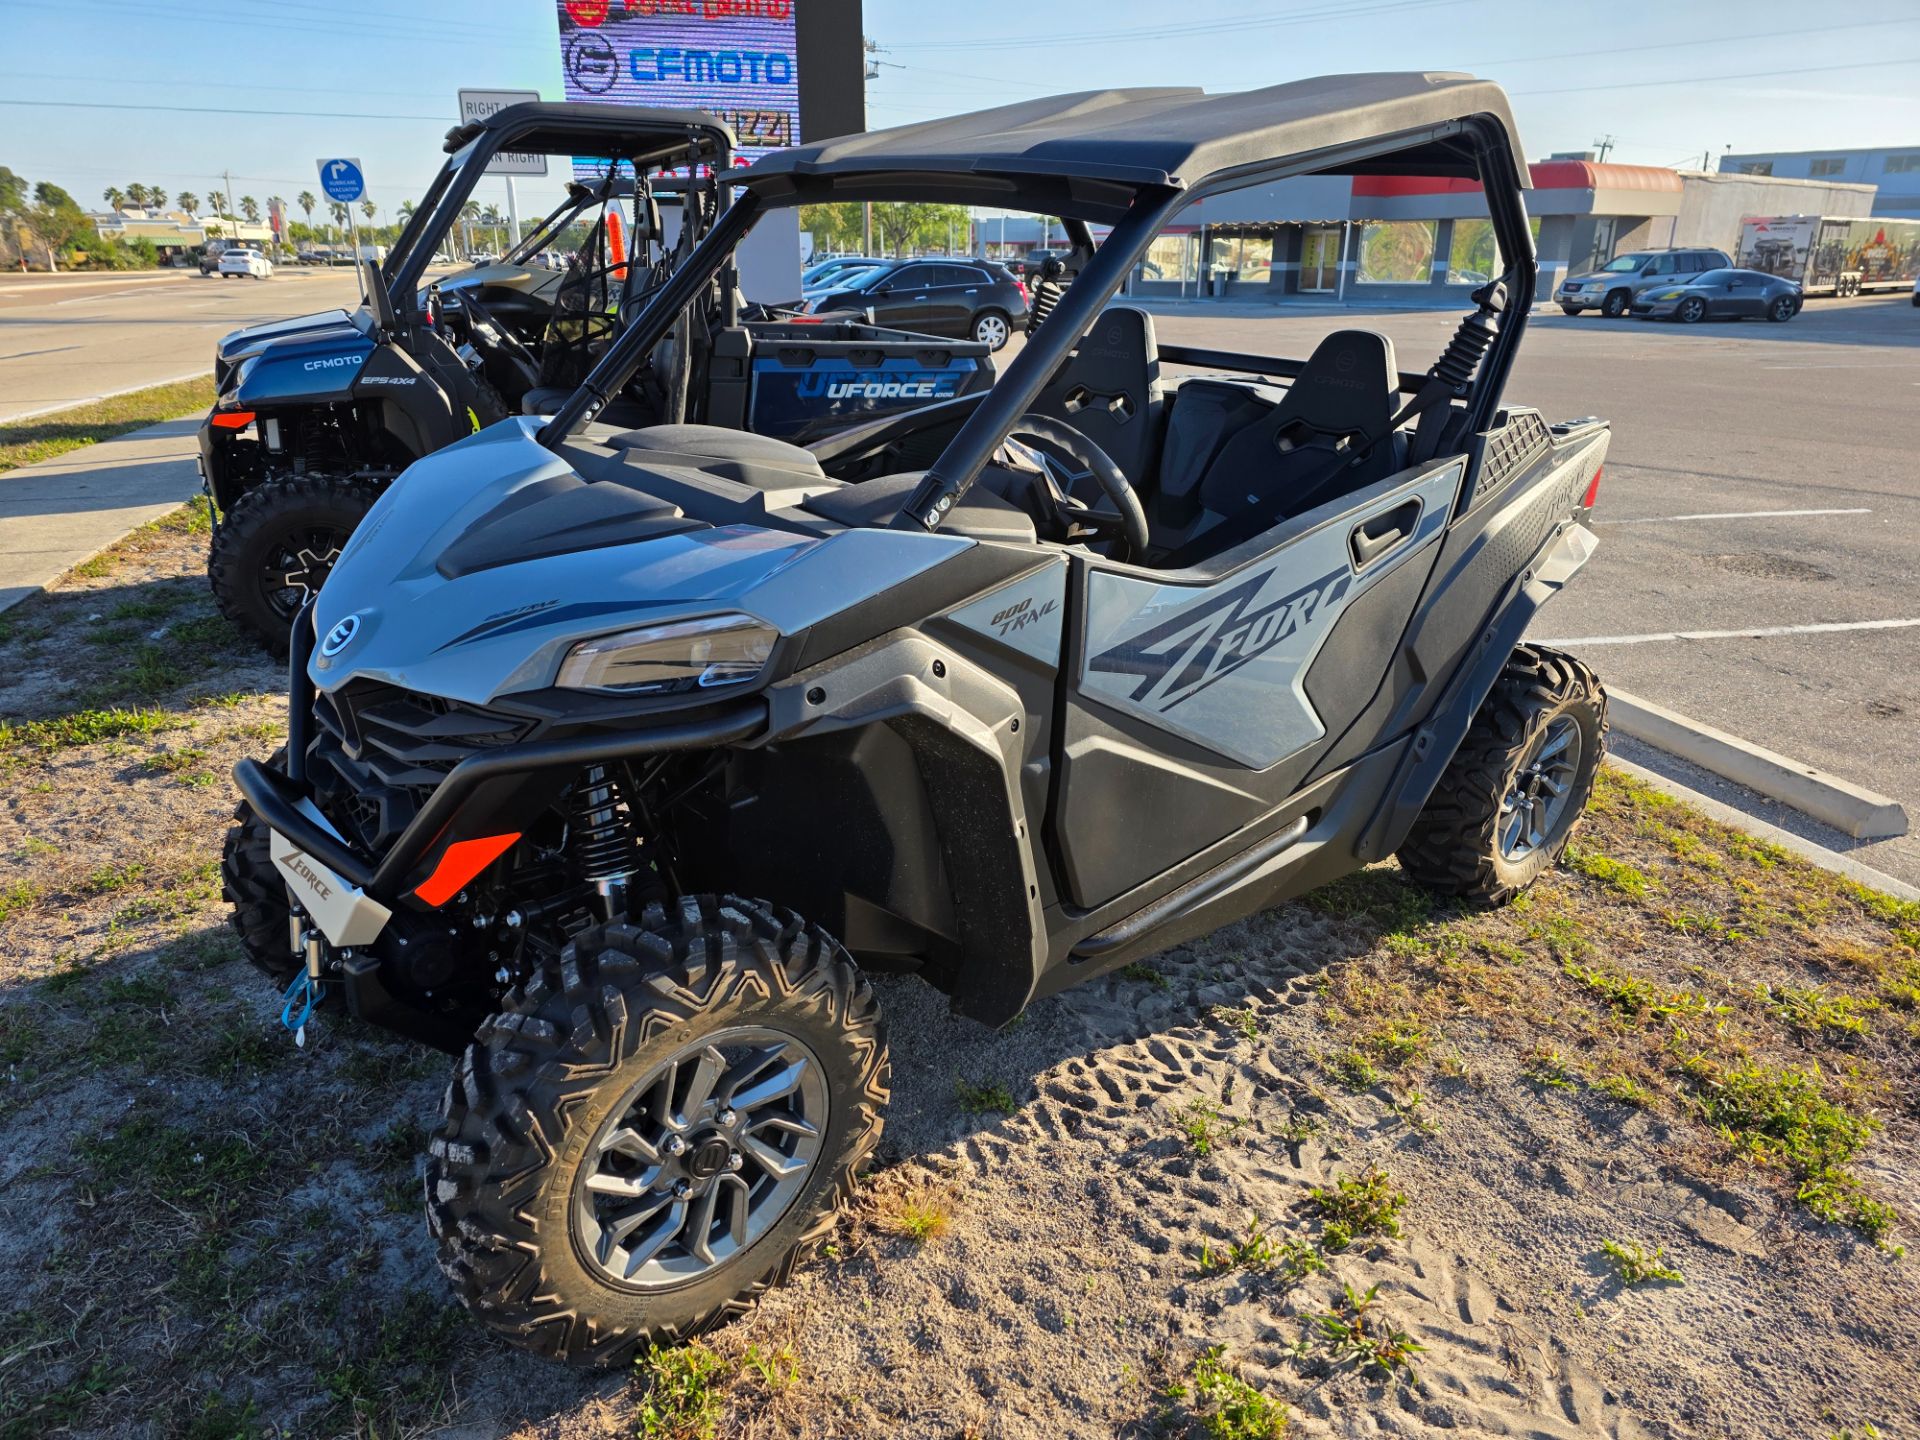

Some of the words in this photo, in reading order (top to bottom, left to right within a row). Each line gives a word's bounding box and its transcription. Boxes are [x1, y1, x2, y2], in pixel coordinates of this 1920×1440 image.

[629, 49, 792, 84] CFMOTO
[465, 102, 500, 115] RIGHT
[304, 355, 363, 371] CFMOTO
[360, 376, 389, 385] EPS
[827, 383, 937, 399] UFORCE
[990, 597, 1033, 626] 800
[999, 598, 1060, 637] TRAIL
[279, 850, 334, 901] ZFORCE
